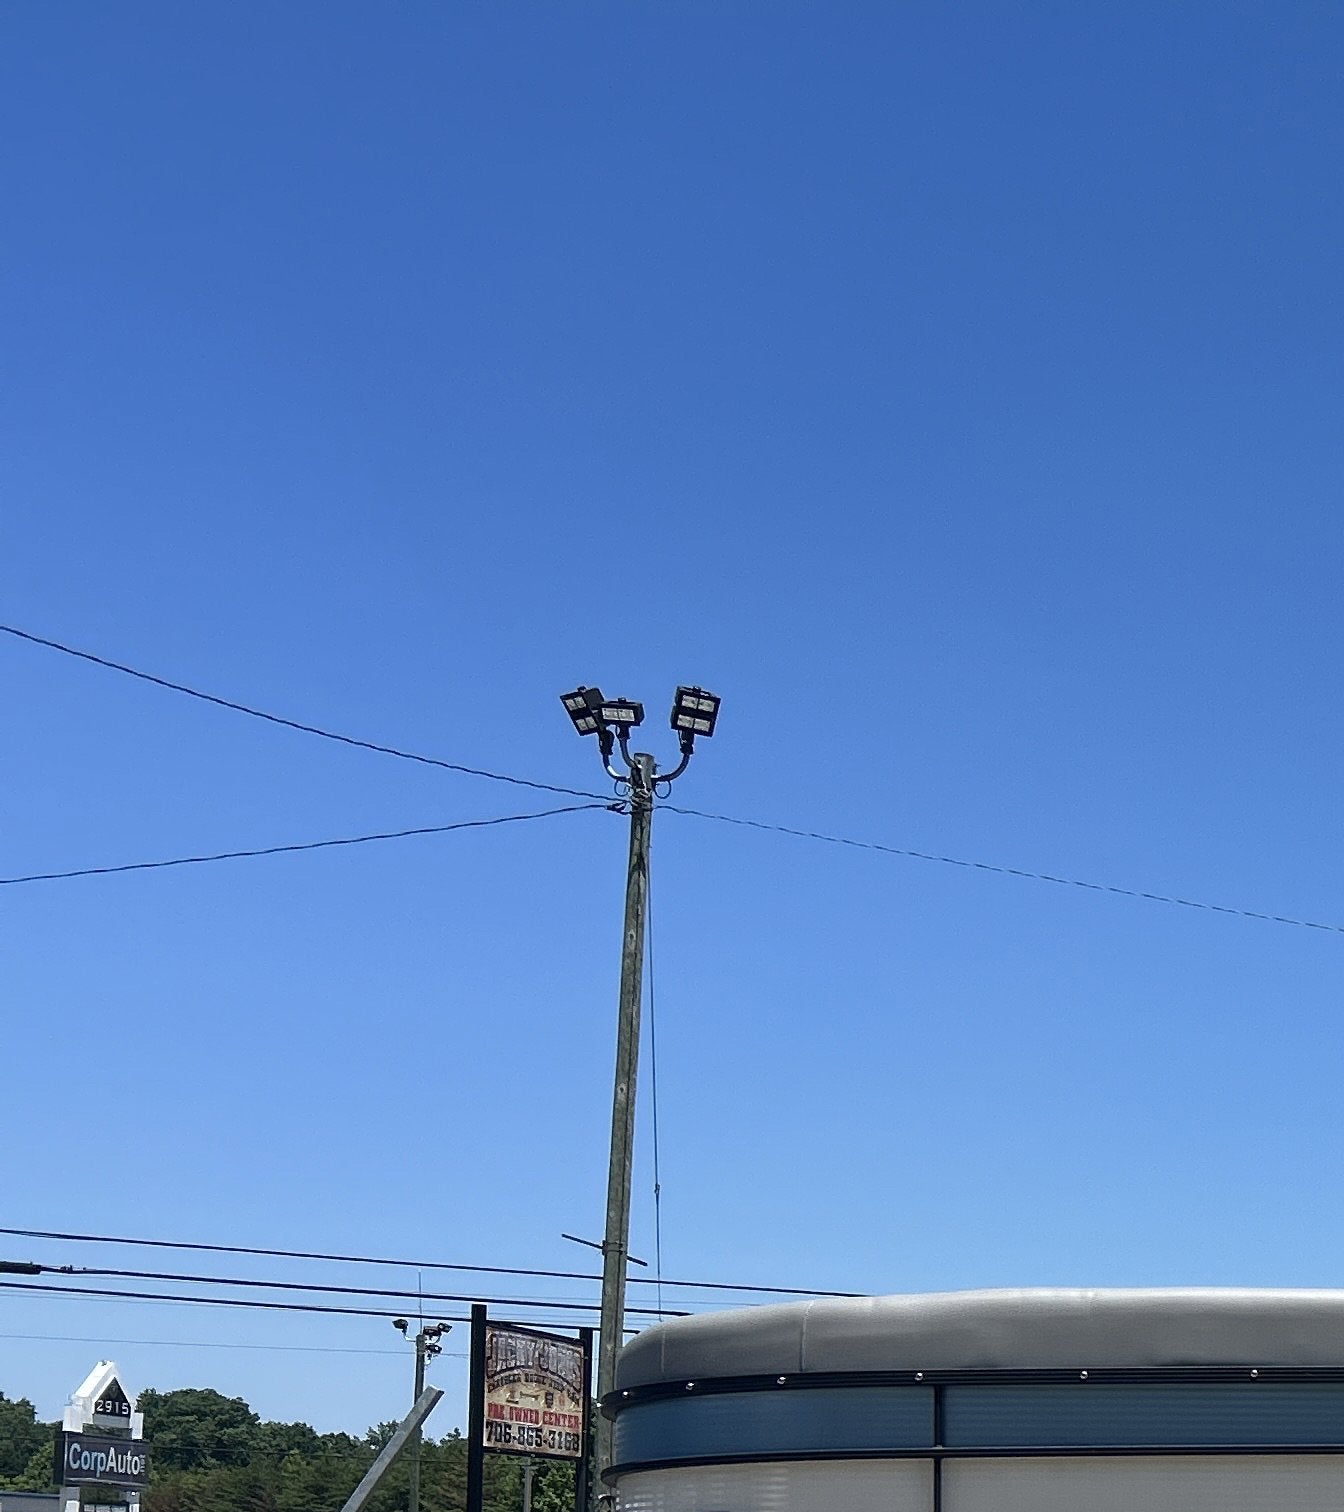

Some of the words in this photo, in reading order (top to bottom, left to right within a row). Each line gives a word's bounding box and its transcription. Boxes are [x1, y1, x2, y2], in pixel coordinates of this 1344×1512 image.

[96, 1399, 130, 1415] 2915
[542, 1410, 580, 1429] CENTER
[69, 1442, 141, 1478] CorpAuto
